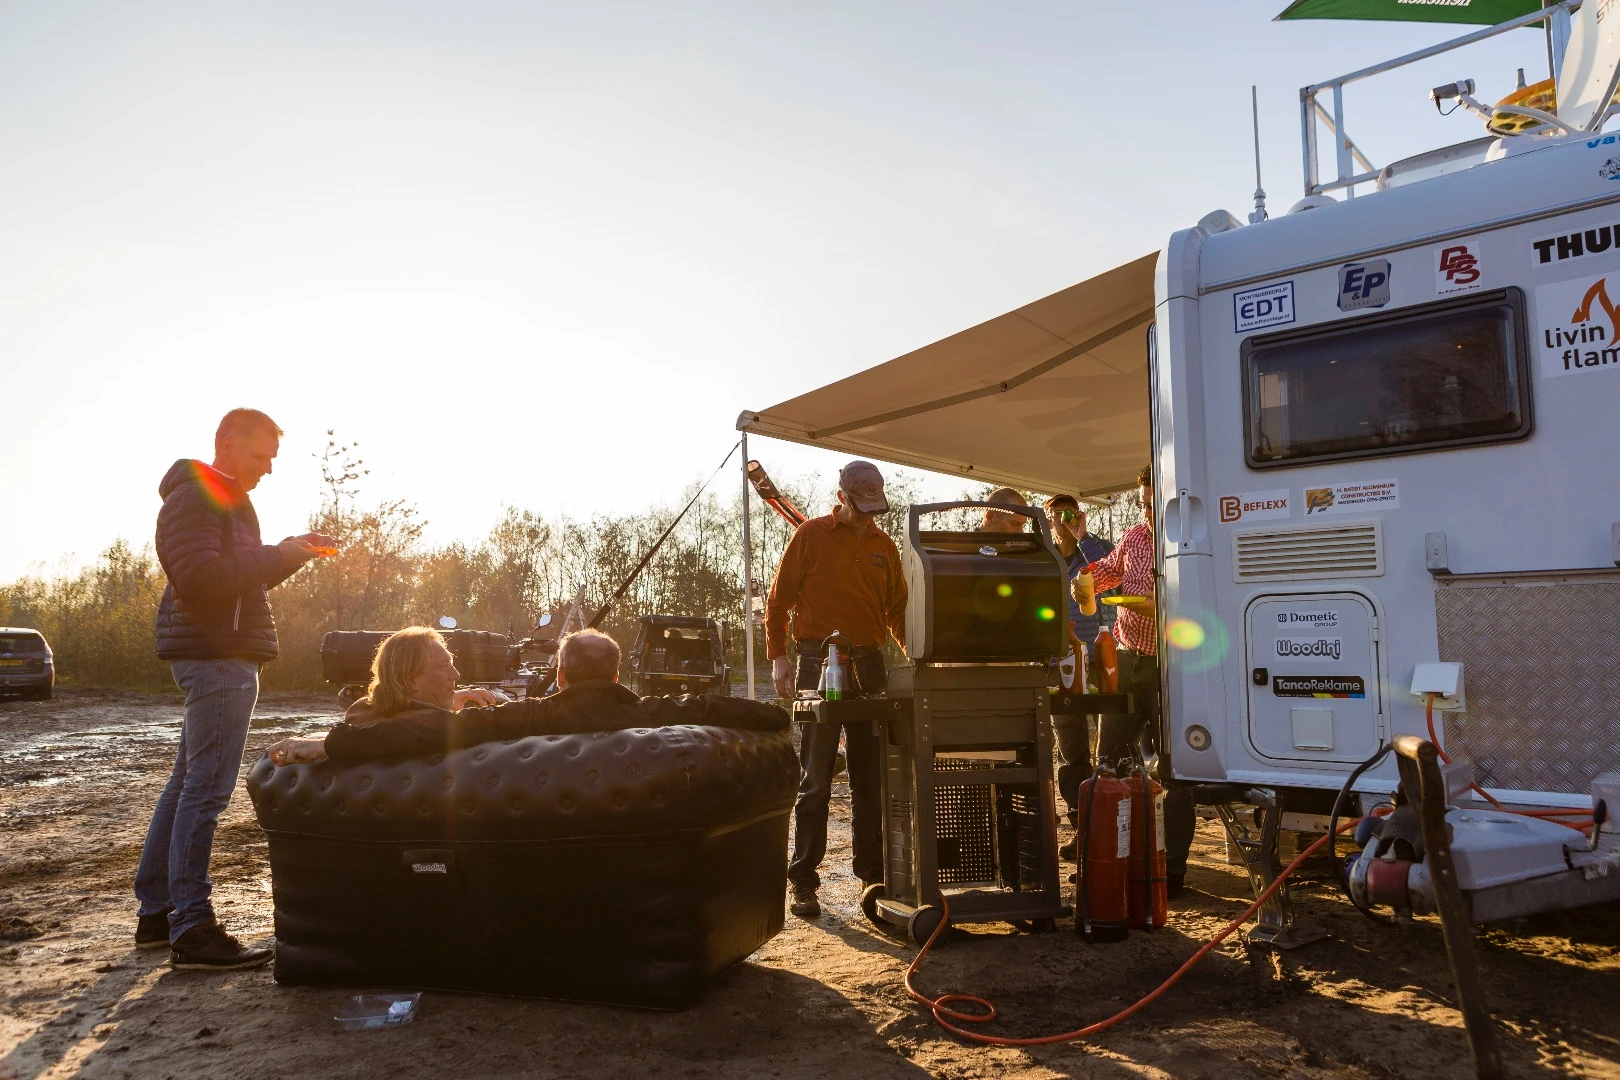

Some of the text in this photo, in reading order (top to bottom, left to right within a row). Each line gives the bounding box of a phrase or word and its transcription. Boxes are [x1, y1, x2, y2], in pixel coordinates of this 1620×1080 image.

[1240, 294, 1288, 319] EDT
[1243, 499, 1287, 512] BEFLEXX
[1290, 611, 1338, 622] Dometic
[1276, 678, 1361, 691] TancoReklame
